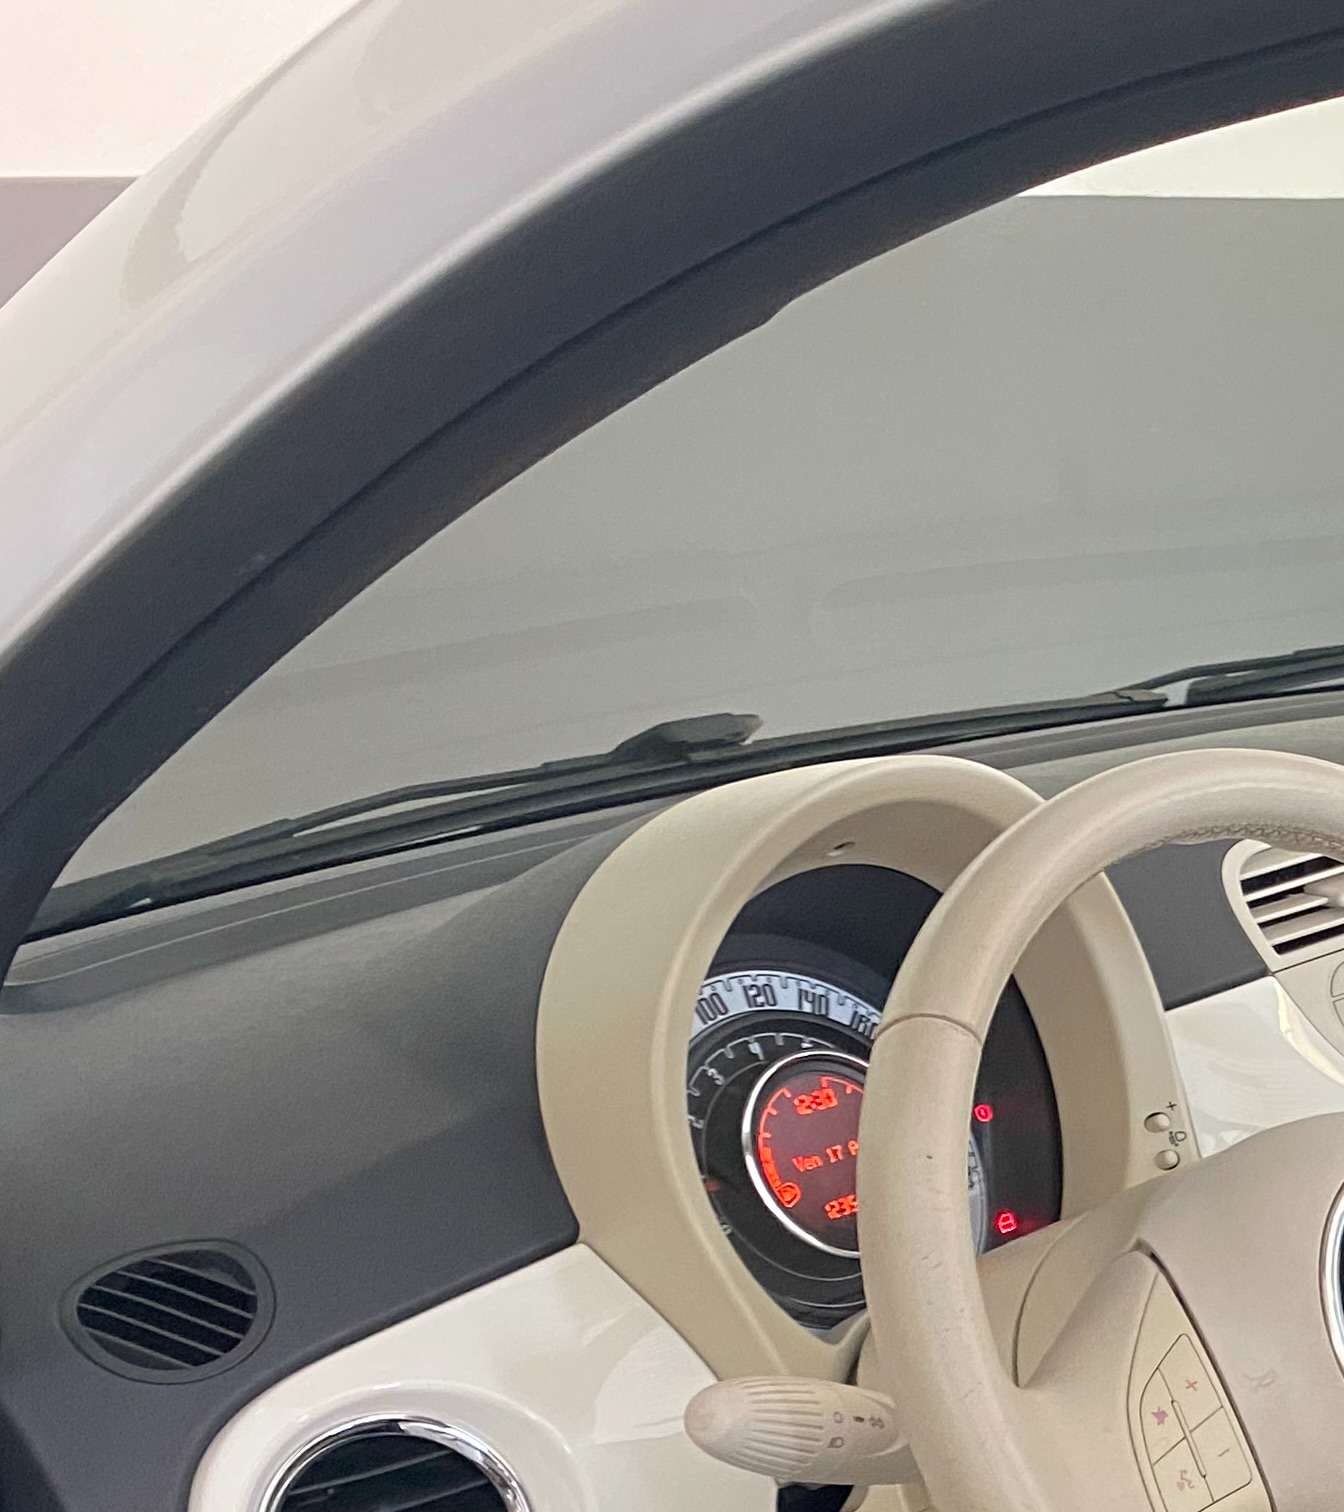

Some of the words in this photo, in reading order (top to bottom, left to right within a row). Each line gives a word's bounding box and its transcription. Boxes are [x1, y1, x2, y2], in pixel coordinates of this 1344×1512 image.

[695, 992, 730, 1026] 100
[743, 983, 778, 1009] 120
[797, 987, 830, 1017] 140
